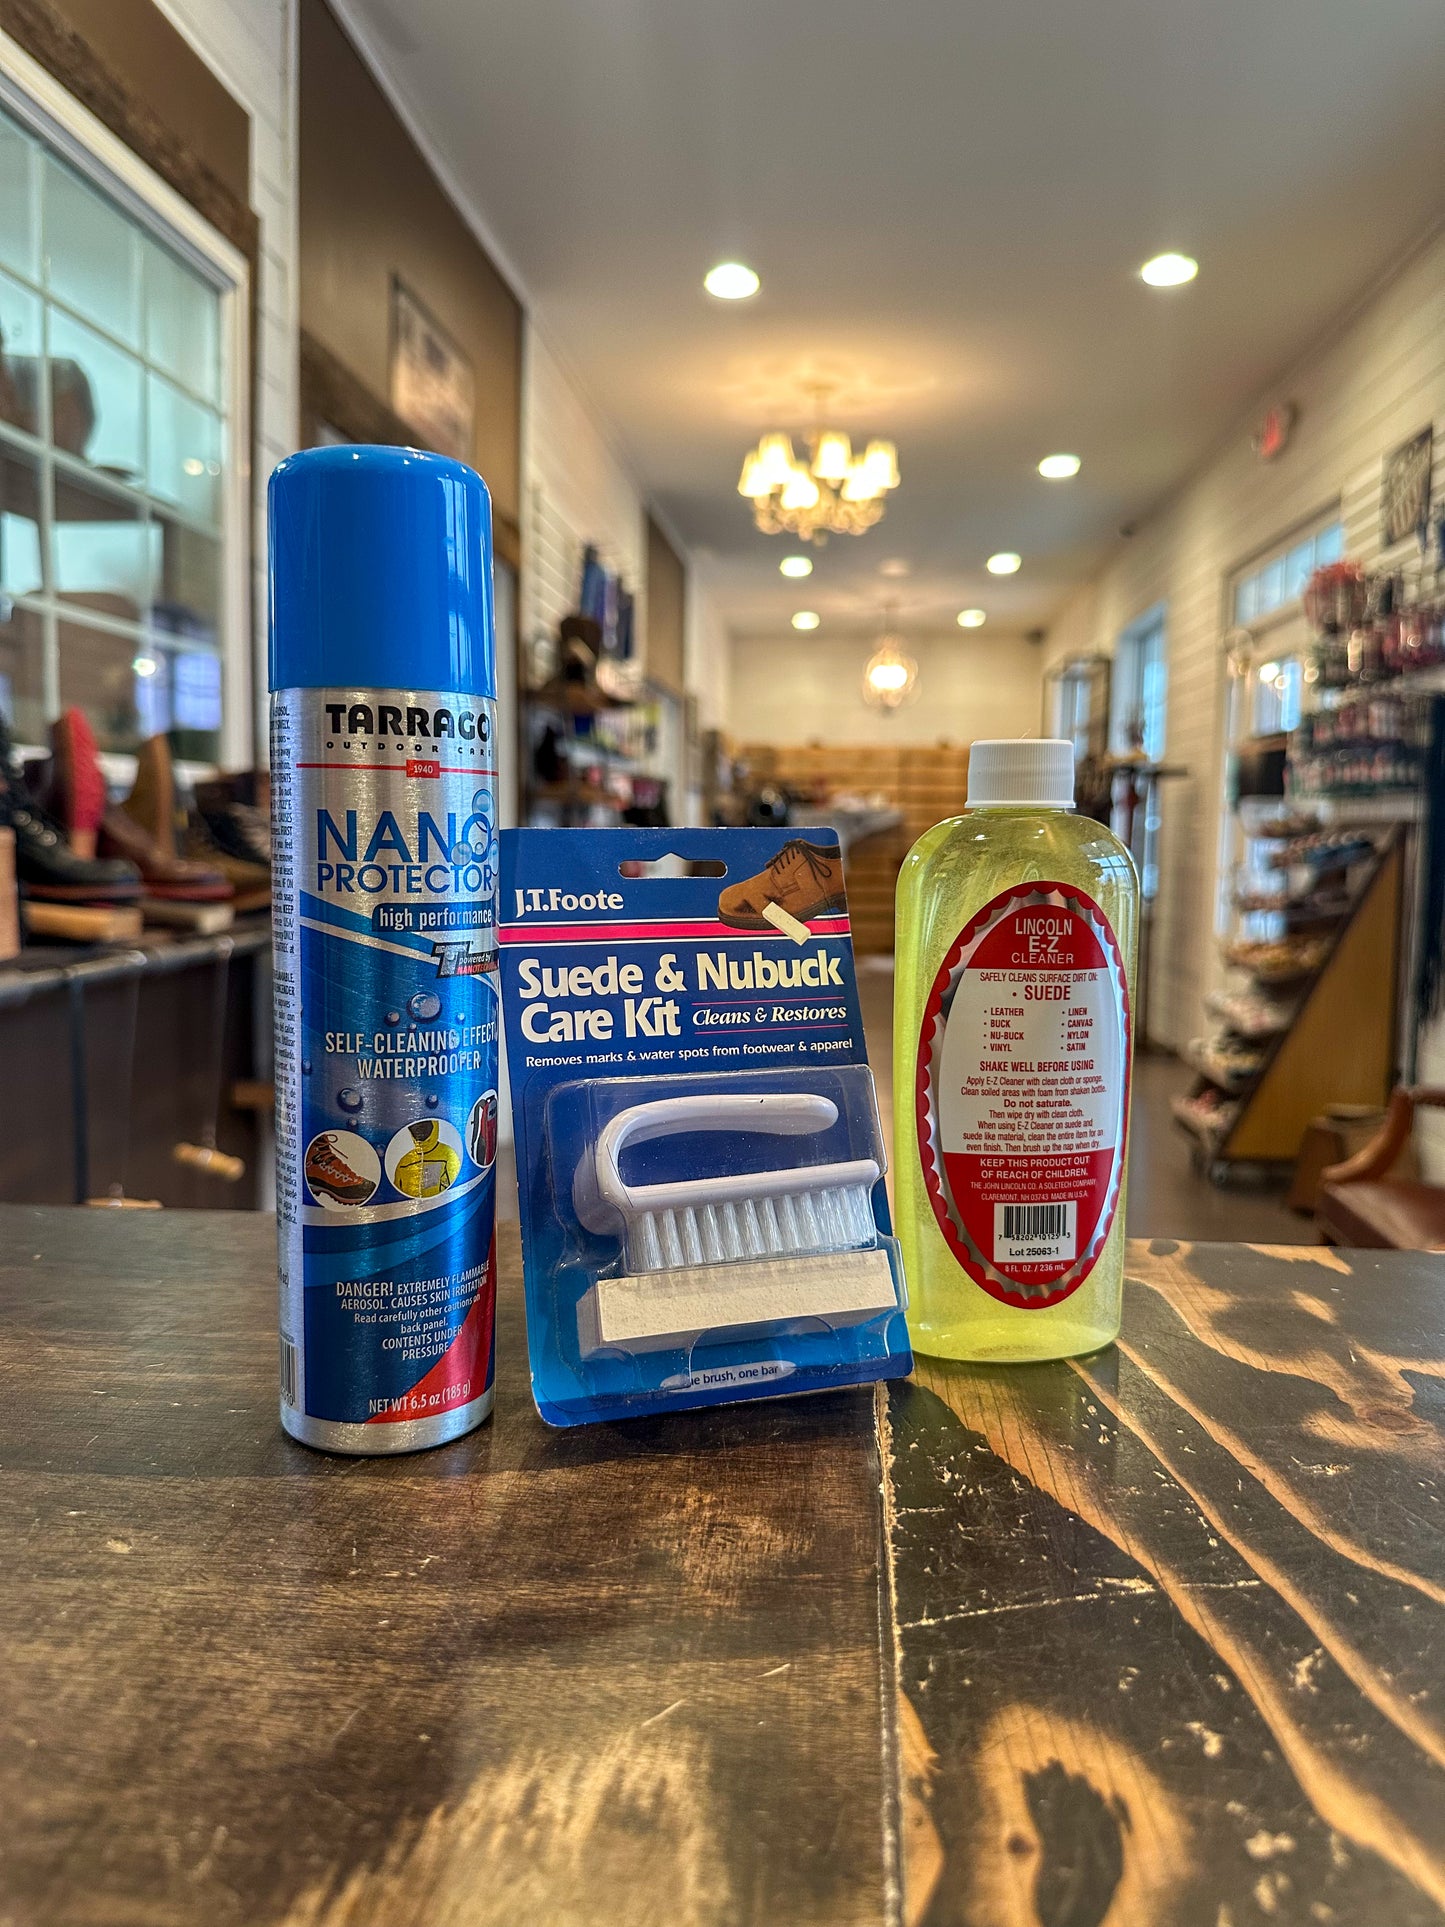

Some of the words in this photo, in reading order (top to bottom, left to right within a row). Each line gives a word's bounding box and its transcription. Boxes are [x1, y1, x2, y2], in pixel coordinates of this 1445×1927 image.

[326, 704, 490, 742] TARRAGO
[326, 742, 438, 752] OUTDOOR
[414, 765, 433, 773] 1940
[317, 809, 491, 863] NANO
[317, 864, 491, 893] PROTECTOR
[515, 889, 623, 918] J.T.Foote
[380, 908, 412, 930] high
[419, 908, 491, 930] performance
[1016, 919, 1072, 935] LINCOLN
[1029, 936, 1058, 952] E-Z
[460, 954, 484, 964] powered
[1012, 953, 1073, 964] CLEANER
[518, 956, 642, 998] Suede
[655, 953, 687, 992] &
[698, 949, 844, 990] Nubuck
[980, 972, 1006, 981] SAFELY
[1009, 973, 1036, 982] CLEANS
[1039, 973, 1070, 982] SURFACE
[1073, 973, 1086, 982] DIRT
[1025, 985, 1070, 1000] SUEDE
[693, 1007, 750, 1026] Cleans
[754, 1007, 767, 1022] &
[771, 1006, 846, 1022] Restores
[991, 1008, 1024, 1016] LEATHER
[1068, 1008, 1087, 1016] LINEN
[520, 1003, 613, 1043] Care
[625, 997, 681, 1037] Kit
[991, 1020, 1010, 1028] BUCK
[1068, 1019, 1093, 1027] CANVAS
[326, 1032, 458, 1053] SELF-CLEANING
[463, 1022, 495, 1046] EFFECT
[991, 1032, 1024, 1040] NU-BUCK
[1067, 1031, 1089, 1039] NYLON
[526, 1055, 582, 1067] Removes
[586, 1052, 623, 1064] marks
[627, 1051, 636, 1061] &
[639, 1049, 675, 1061] water
[678, 1048, 709, 1061] spots
[712, 1045, 739, 1056] from
[743, 1042, 795, 1055] footwear
[799, 1040, 807, 1051] &
[810, 1038, 853, 1053] apparel
[1067, 1043, 1085, 1051] SATIN
[357, 1051, 480, 1078] WATERPROOFER
[980, 1061, 1008, 1071] SHAKE
[1011, 1062, 1034, 1072] WELL
[1038, 1061, 1068, 1072] BEFORE
[1072, 1060, 1094, 1071] USING
[967, 1076, 984, 1086] Apply
[986, 1076, 997, 1085] E-Z
[1000, 1076, 1024, 1085] Cleaner
[1027, 1076, 1040, 1085] with
[1042, 1076, 1058, 1085] clean
[1060, 1076, 1074, 1084] cloth
[961, 1086, 979, 1095] Clean
[981, 1087, 999, 1096] soiled
[1022, 1088, 1035, 1096] with
[1038, 1088, 1053, 1096] foam
[1055, 1087, 1068, 1096] from
[1070, 1086, 1090, 1094] shaken
[1004, 1099, 1016, 1107] Do
[1019, 1099, 1033, 1107] not
[1036, 1099, 1072, 1107] saturate.
[989, 1110, 1005, 1118] Then
[1007, 1110, 1022, 1119] wipe
[1025, 1110, 1034, 1120] dry
[1036, 1110, 1049, 1118] with
[1051, 1110, 1067, 1118] clean
[1069, 1109, 1083, 1118] cloth.
[978, 1121, 996, 1129] When
[998, 1121, 1015, 1131] using
[1018, 1121, 1028, 1130] E-Z
[1031, 1121, 1053, 1130] Cleaner
[1065, 1119, 1081, 1128] suede
[1083, 1118, 1092, 1127] and
[963, 1132, 982, 1140] suede
[984, 1132, 995, 1140] like
[998, 1132, 1025, 1142] material,
[1028, 1132, 1045, 1141] clean
[1047, 1132, 1056, 1140] the
[1058, 1131, 1074, 1140] entire
[1076, 1130, 1087, 1138] item
[966, 1143, 981, 1151] even
[984, 1143, 1002, 1151] finish.
[1005, 1143, 1020, 1152] Then
[1023, 1143, 1040, 1152] brush
[1042, 1144, 1050, 1152] up
[1052, 1142, 1061, 1151] the
[1063, 1142, 1073, 1151] nap
[1075, 1141, 1089, 1150] when
[981, 1158, 1005, 1166] KEEP
[1007, 1159, 1028, 1167] THIS
[1031, 1158, 1072, 1167] PRODUCT
[1074, 1156, 1090, 1165] OUT
[981, 1170, 994, 1178] OF
[997, 1170, 1028, 1178] REACH
[1031, 1170, 1043, 1178] OF
[1045, 1168, 1088, 1178] CHILDREN.
[1044, 1181, 1071, 1189] SOLETECH
[1073, 1179, 1096, 1187] COMPANY
[1068, 1191, 1073, 1199] IN
[1010, 1248, 1024, 1256] Lot
[1026, 1247, 1059, 1255] 25063-1
[337, 1282, 393, 1296] DANGER!
[398, 1276, 450, 1295] EXTREMELY
[452, 1260, 489, 1284] FLAMMABLE
[341, 1299, 388, 1309] AEROSOL.
[391, 1295, 428, 1308] CAUSES
[430, 1290, 450, 1303] SKIN
[452, 1275, 487, 1297] IRRITATION
[355, 1313, 376, 1323] Read
[379, 1310, 417, 1322] carefully
[420, 1307, 442, 1317] other
[444, 1297, 473, 1313] cautions
[474, 1294, 480, 1303] on
[401, 1322, 421, 1333] back
[423, 1317, 448, 1332] panel.
[382, 1334, 432, 1349] CONTENTS
[435, 1325, 462, 1342] UNDER
[403, 1342, 448, 1360] PRESSURE
[703, 1371, 736, 1384] brush,
[739, 1368, 758, 1378] one
[762, 1366, 778, 1375] bar
[369, 1400, 389, 1413] NET
[391, 1397, 408, 1411] WT
[411, 1394, 427, 1409] 6.5
[430, 1394, 440, 1405] oz
[443, 1382, 461, 1404] (185
[462, 1379, 471, 1396] g)
